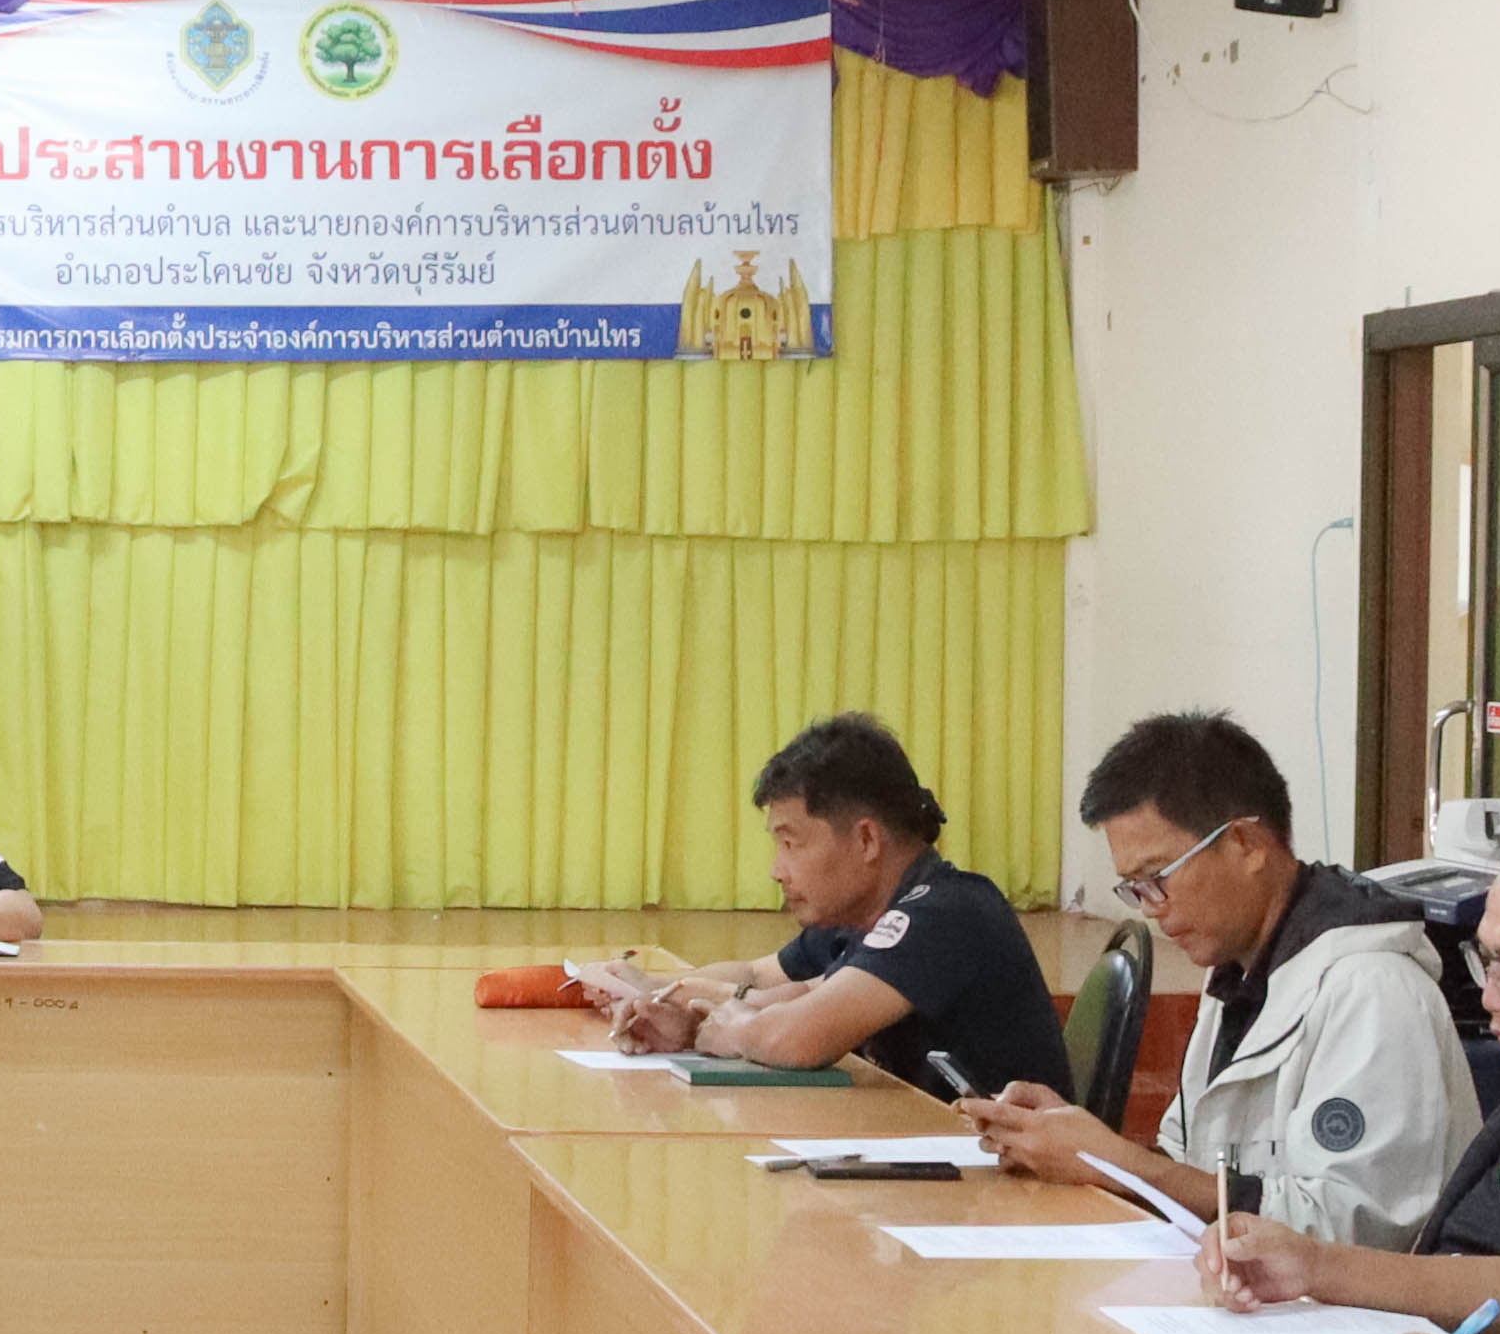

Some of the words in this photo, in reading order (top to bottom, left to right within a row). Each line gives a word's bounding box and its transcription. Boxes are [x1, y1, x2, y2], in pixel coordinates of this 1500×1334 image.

[244, 200, 800, 237] และนายกองค์การบริหารส่วนตำบลบ้านไทร
[56, 250, 293, 286] อำเภอประโคนชัย
[306, 251, 496, 295] จังหวัดบุรีรัมย์
